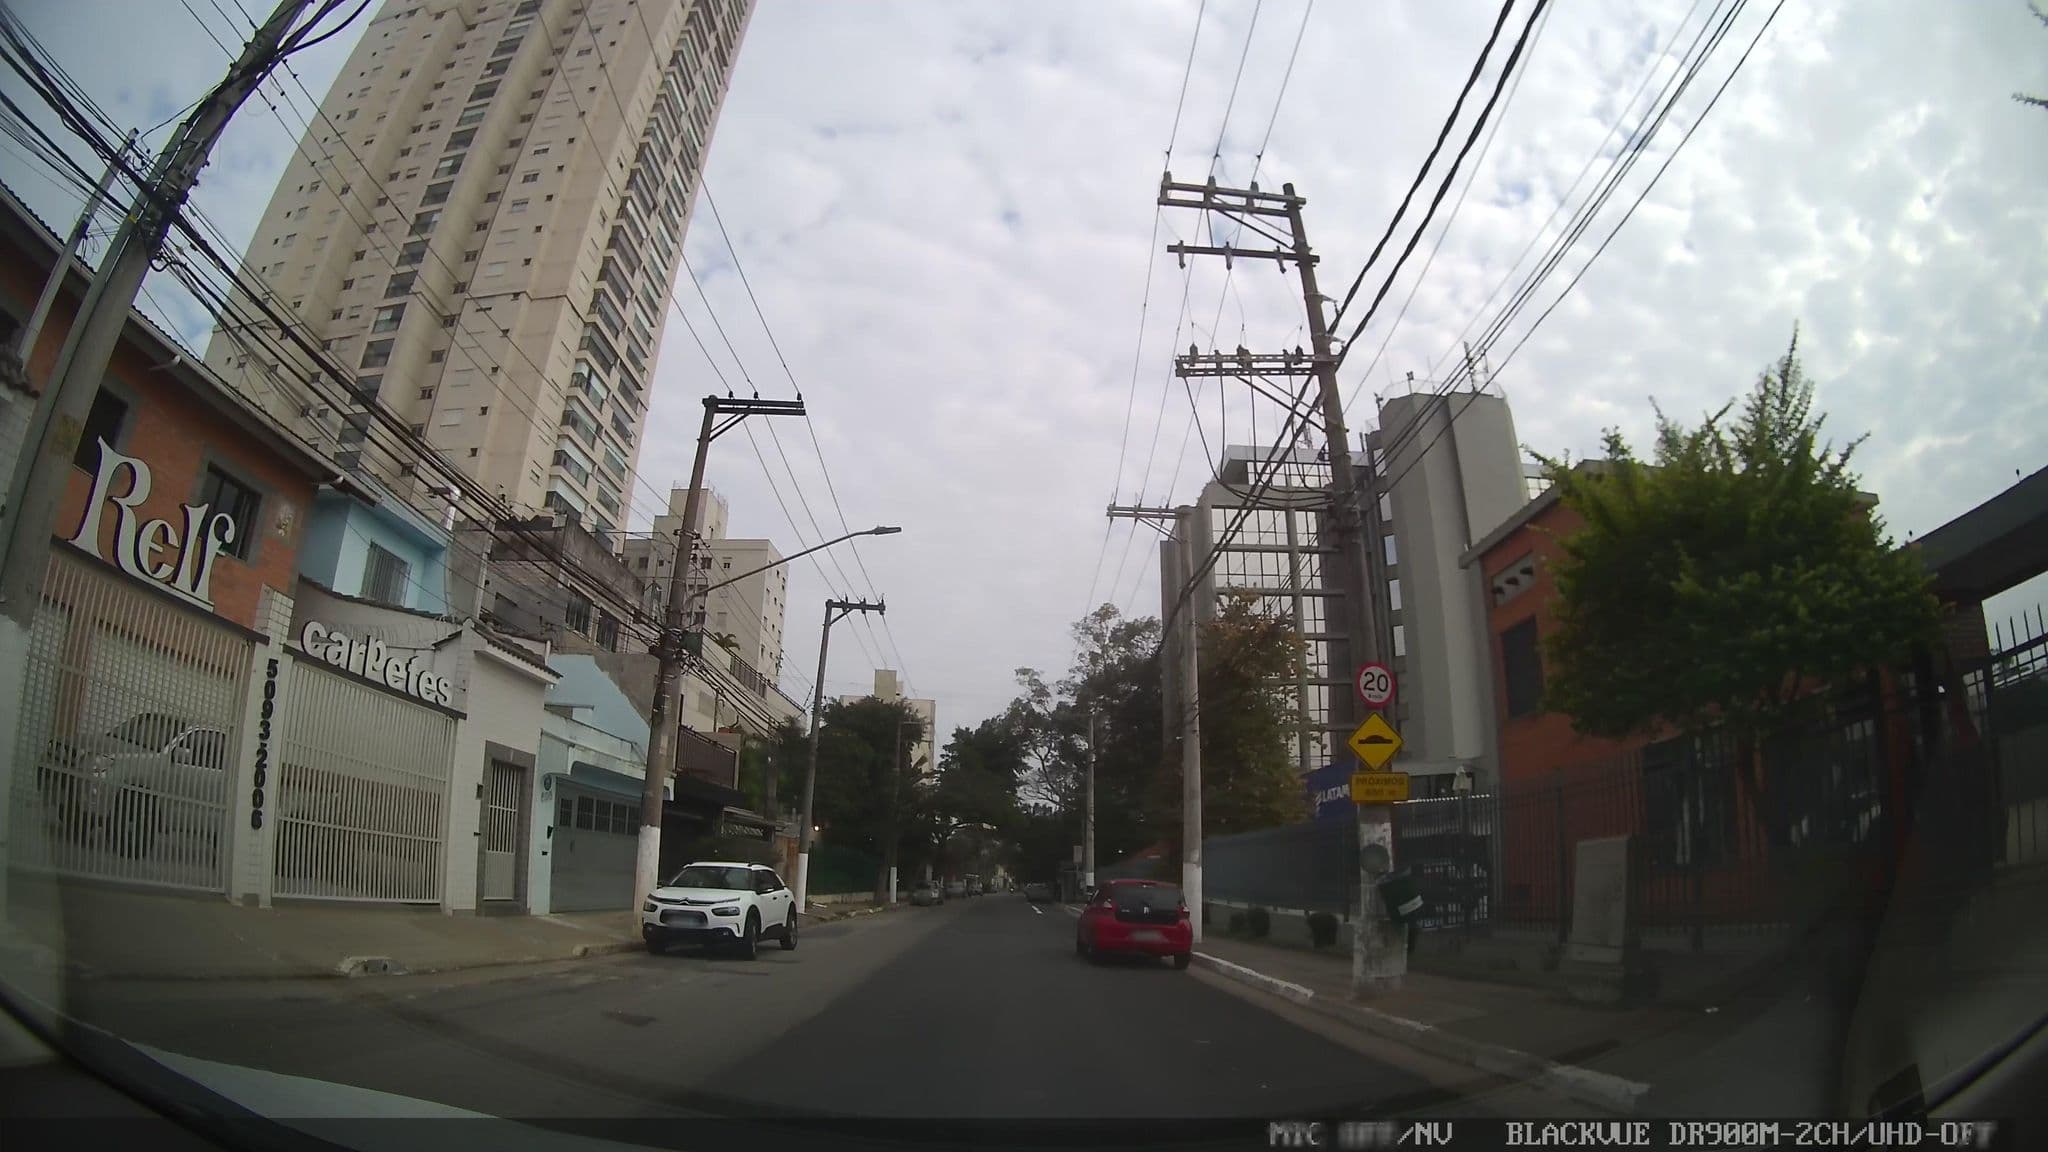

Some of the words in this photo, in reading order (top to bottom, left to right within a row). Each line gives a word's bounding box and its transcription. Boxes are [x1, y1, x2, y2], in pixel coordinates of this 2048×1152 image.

[66, 435, 236, 612] Relf
[301, 620, 454, 707] carpetes
[1363, 671, 1389, 692] 20
[1322, 783, 1350, 802] LATAM
